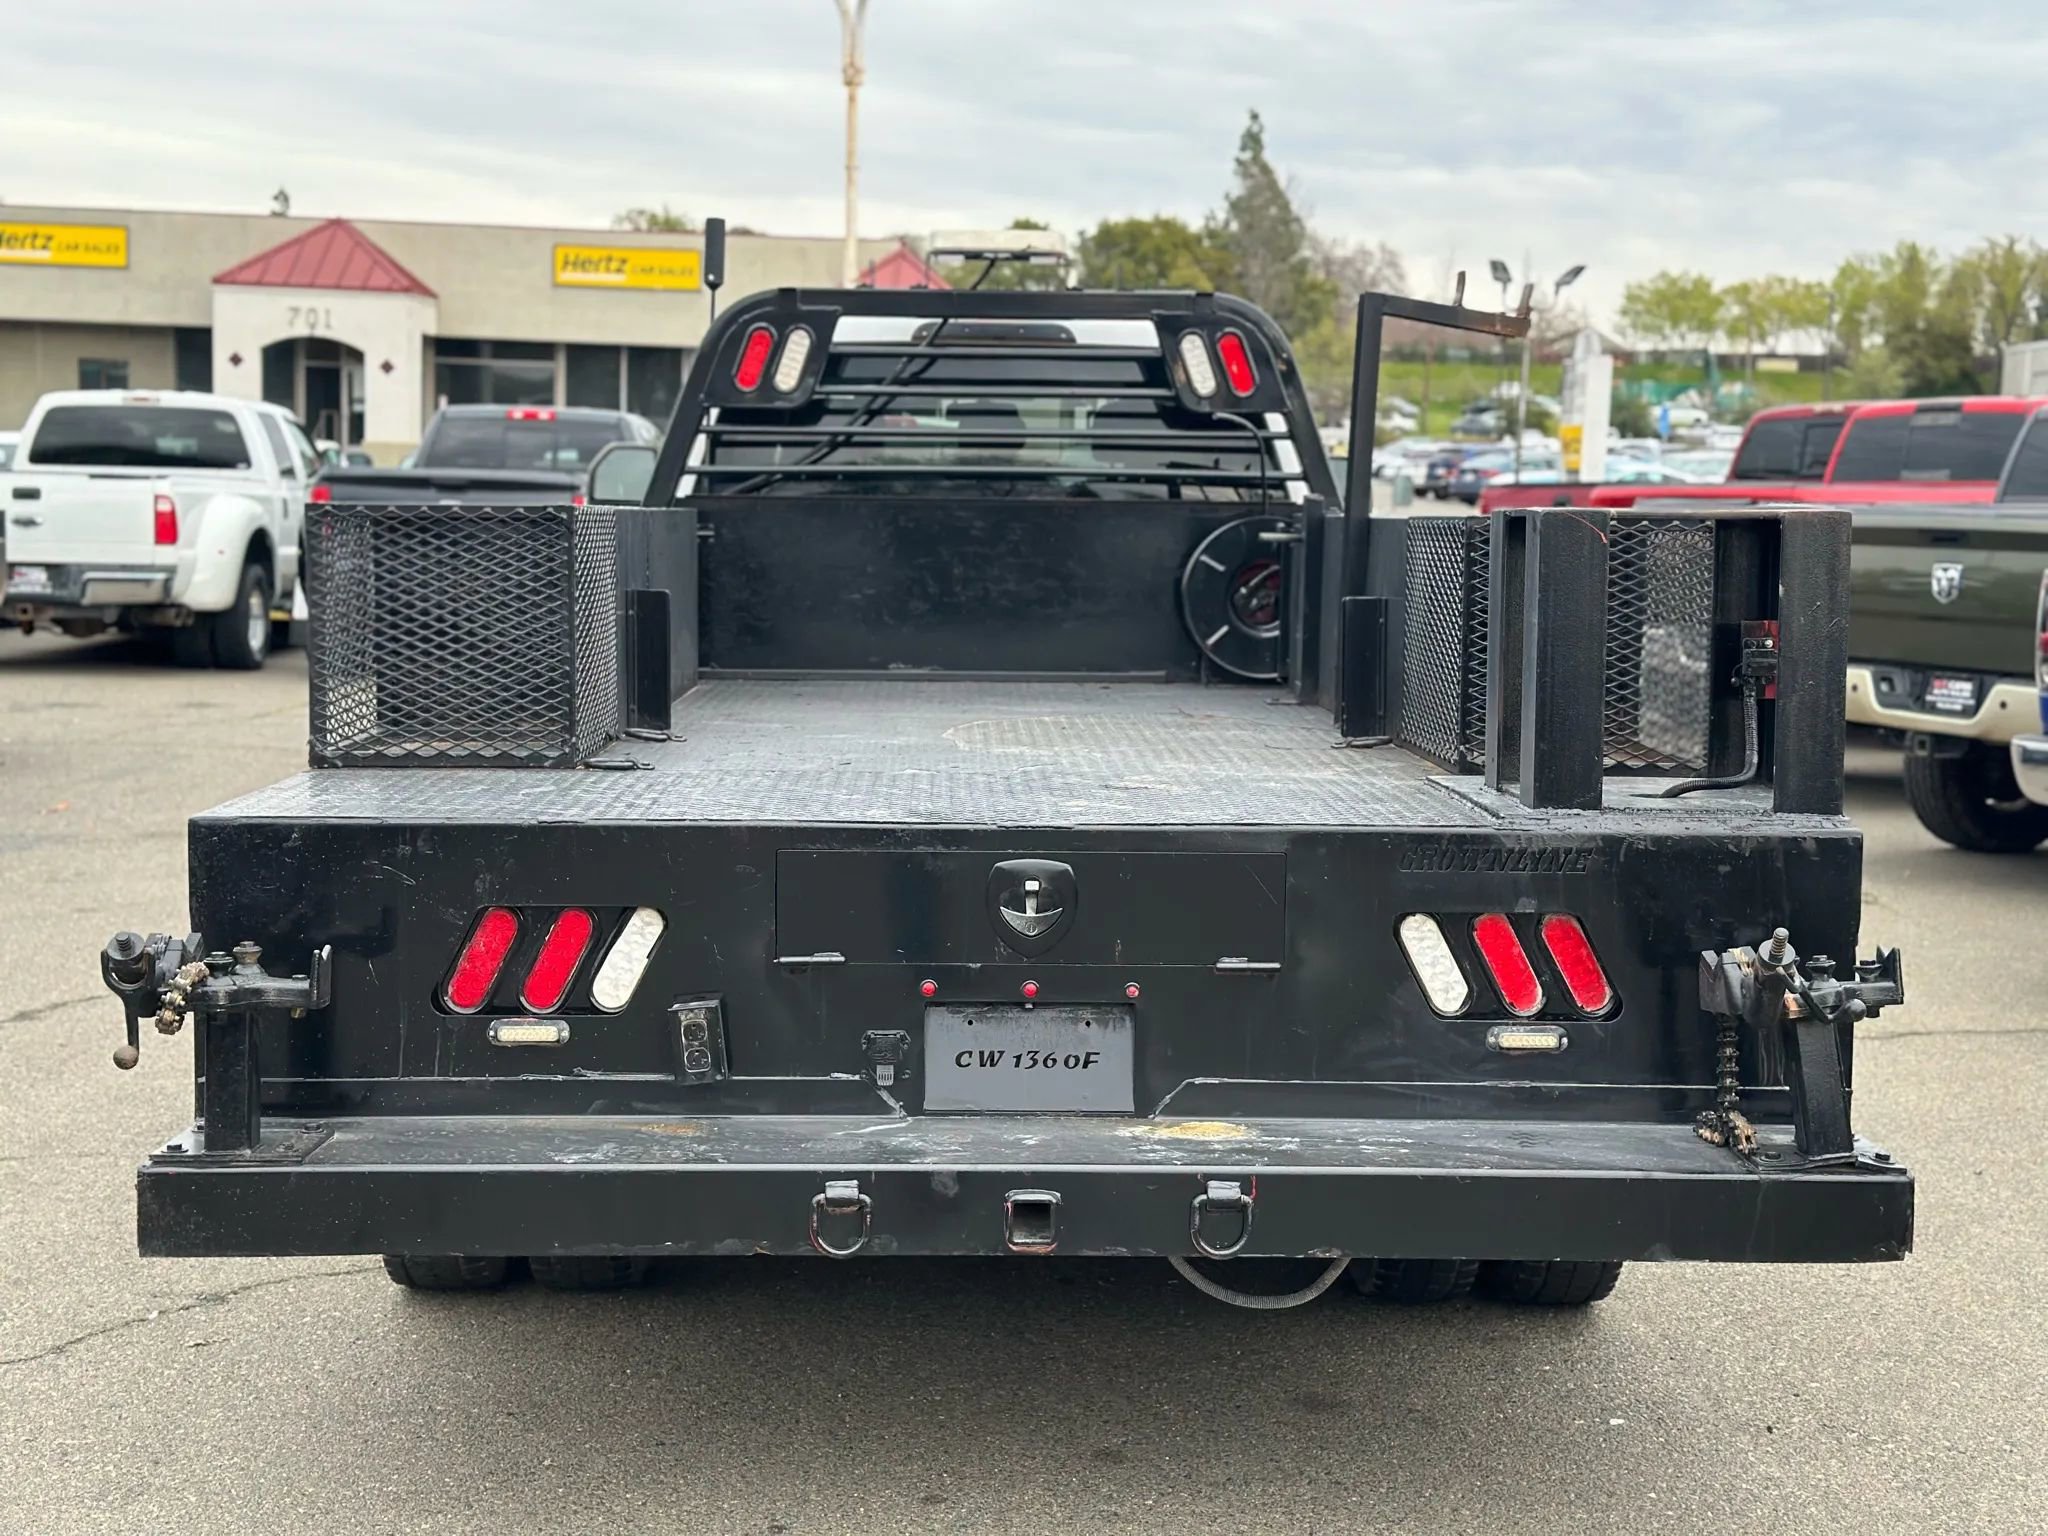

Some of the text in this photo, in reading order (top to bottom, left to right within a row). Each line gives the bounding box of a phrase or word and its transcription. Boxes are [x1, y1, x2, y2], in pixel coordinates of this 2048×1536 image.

[561, 253, 628, 273] Hertz
[287, 305, 333, 330] 701
[955, 1050, 1005, 1068] CW
